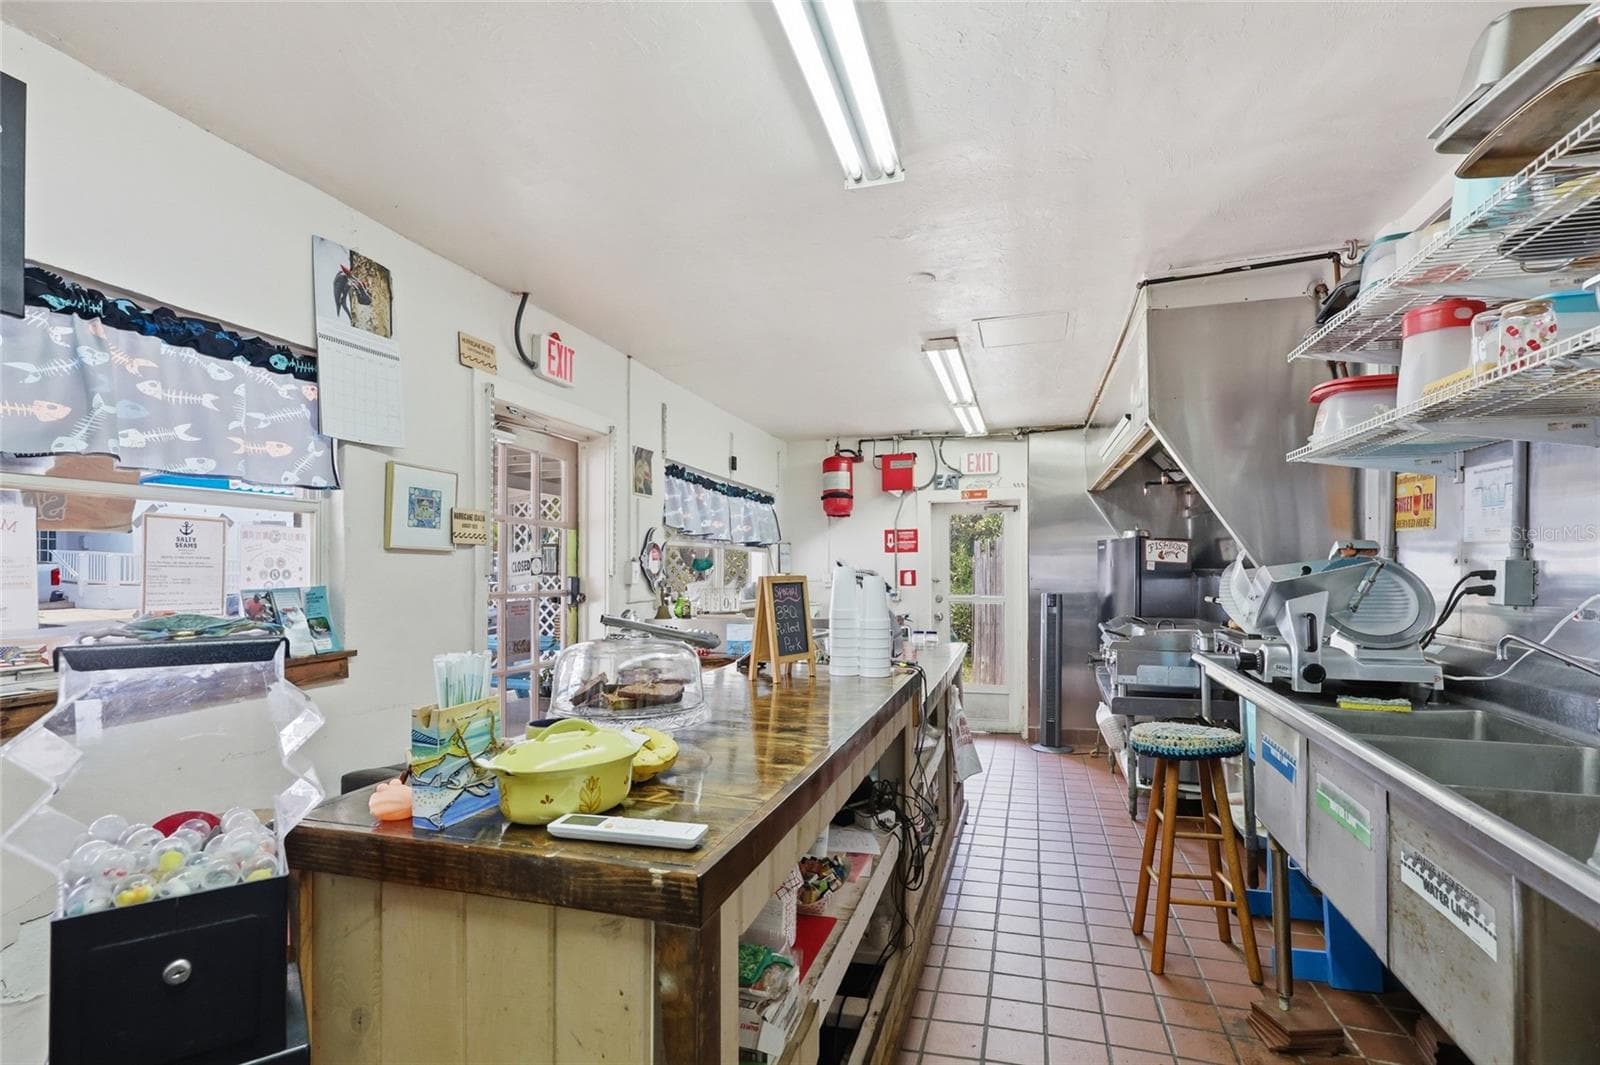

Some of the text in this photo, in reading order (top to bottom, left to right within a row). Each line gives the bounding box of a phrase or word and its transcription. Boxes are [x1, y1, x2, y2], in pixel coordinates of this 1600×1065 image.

[548, 339, 575, 383] EXIT
[967, 453, 993, 472] EXIT
[934, 474, 959, 490] EAT
[1423, 494, 1433, 511] TEA
[1416, 518, 1431, 527] HERE
[512, 560, 530, 573] CLOSED
[1423, 878, 1471, 927] WATER LINE
